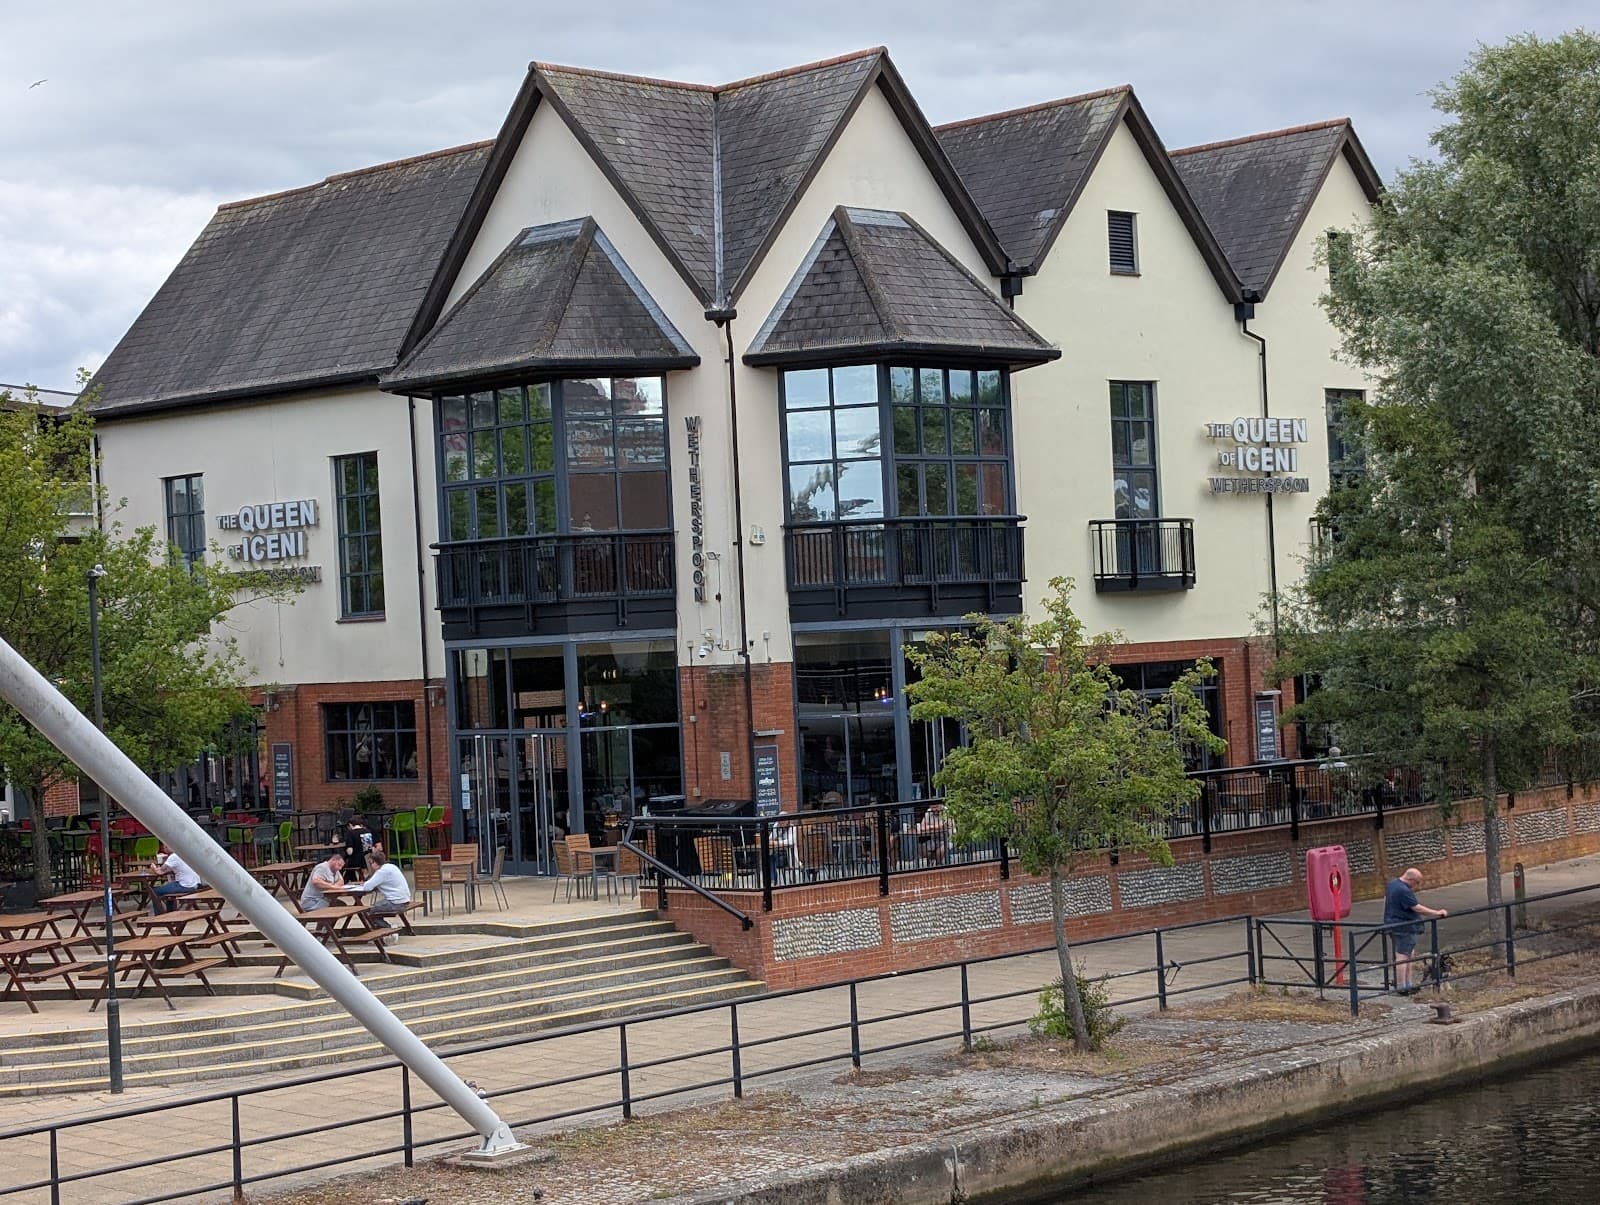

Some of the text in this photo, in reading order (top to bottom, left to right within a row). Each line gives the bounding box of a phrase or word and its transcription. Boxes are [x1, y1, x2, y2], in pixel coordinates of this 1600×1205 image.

[1208, 417, 1307, 443] THE QUEEN
[1220, 446, 1297, 472] OF ICENI
[1211, 478, 1309, 493] WETHERSPOON
[216, 499, 317, 532] THE QUEEN
[685, 416, 704, 602] WETHERSPOON
[227, 531, 305, 561] OF ICENI
